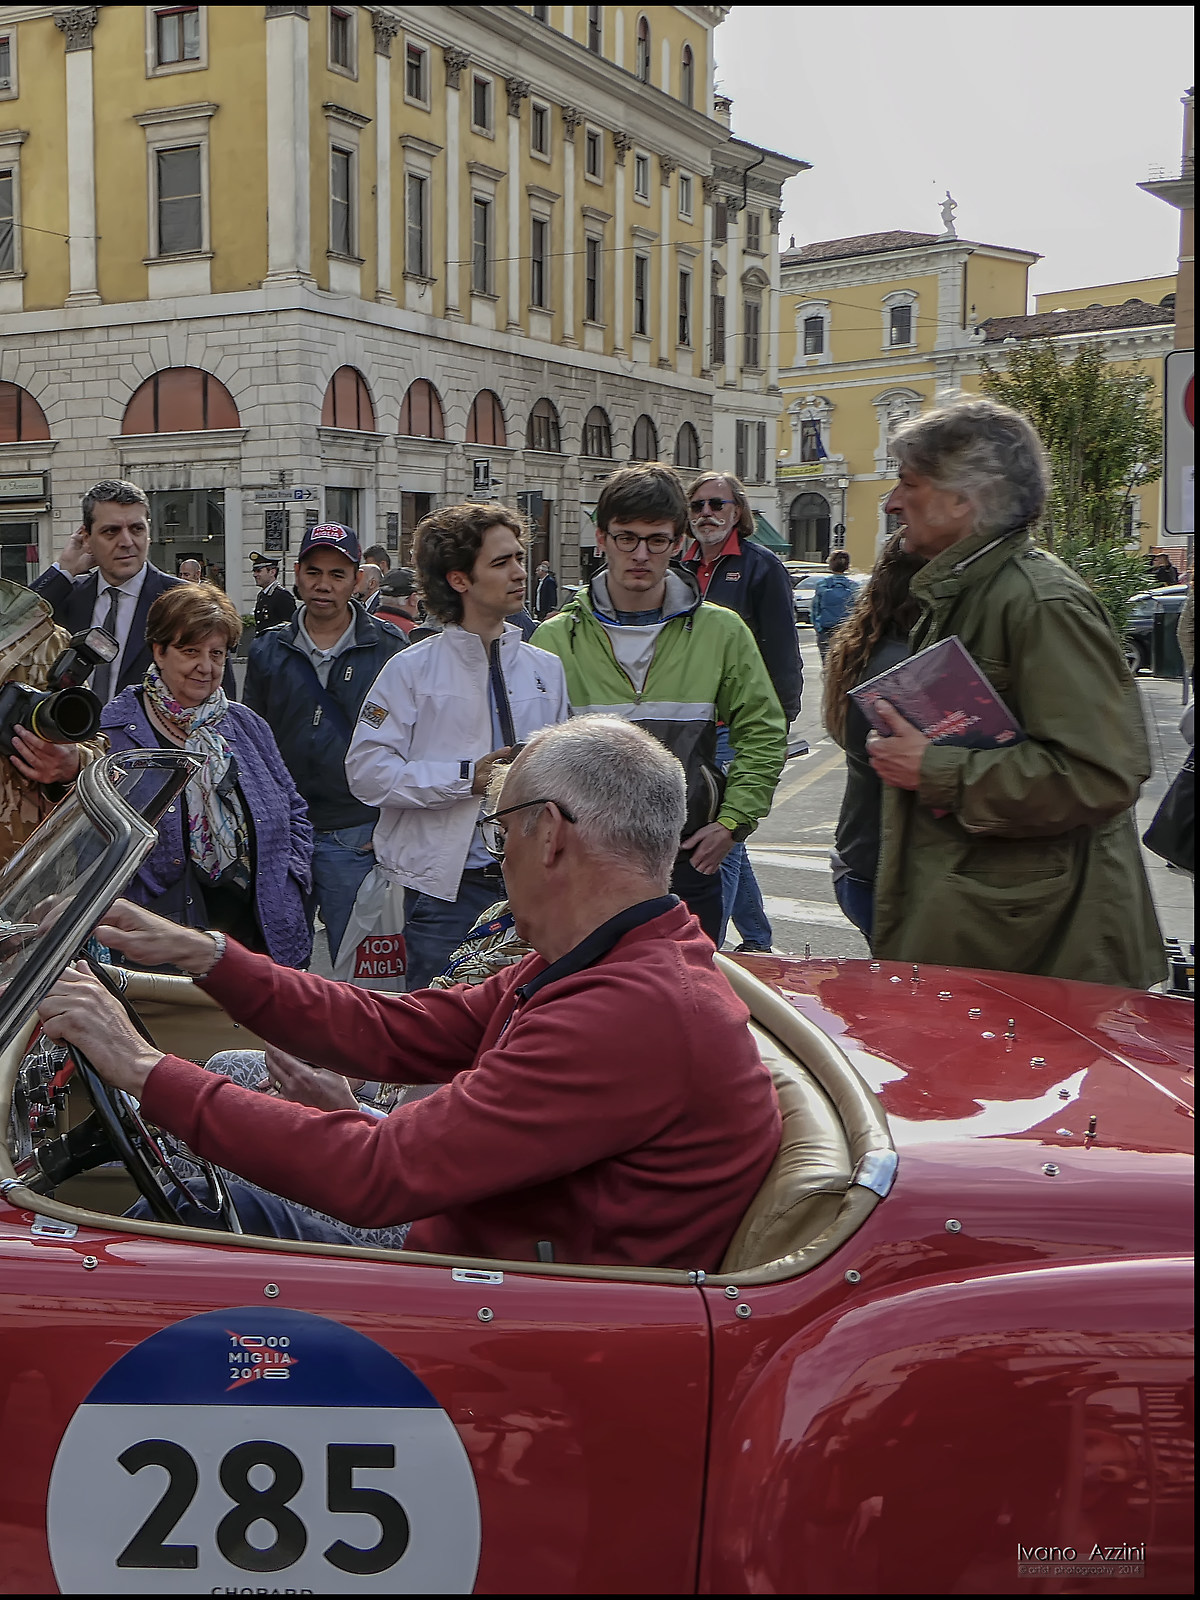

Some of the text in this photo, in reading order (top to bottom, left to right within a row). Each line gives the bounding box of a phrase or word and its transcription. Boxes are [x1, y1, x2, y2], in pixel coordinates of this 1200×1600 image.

[358, 958, 405, 975] MIGLA
[229, 1335, 291, 1348] 1000
[228, 1352, 292, 1364] MIGLIA
[229, 1367, 291, 1380] 2018
[115, 1438, 410, 1575] 285
